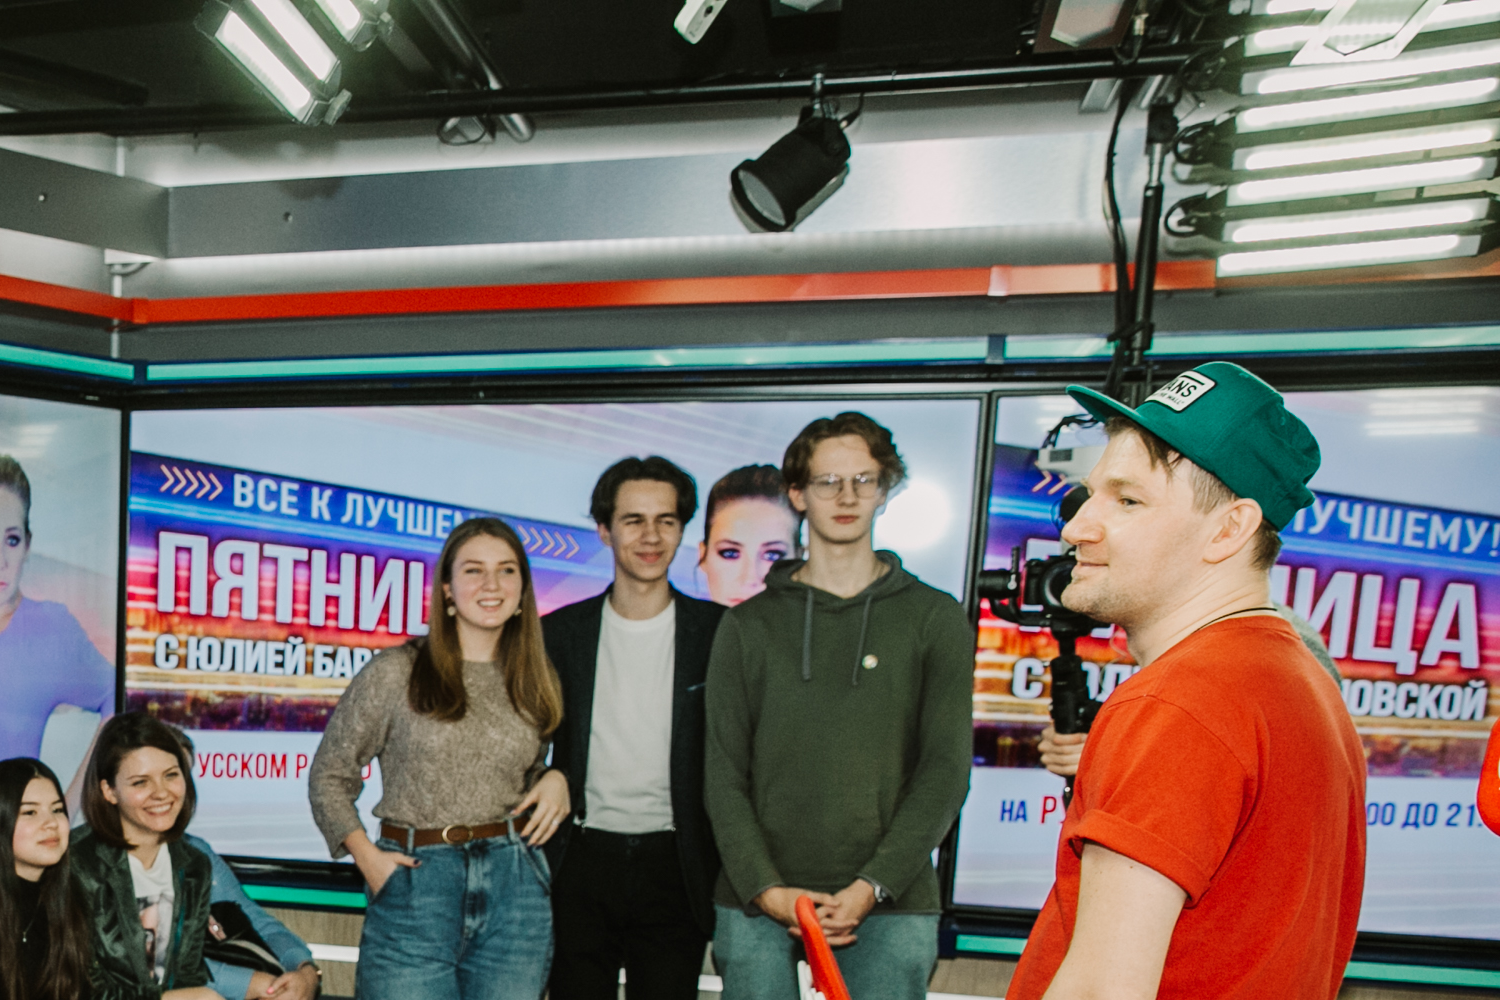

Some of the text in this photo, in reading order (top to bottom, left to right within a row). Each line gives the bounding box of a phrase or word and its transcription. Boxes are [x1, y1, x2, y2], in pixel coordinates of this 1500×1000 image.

[1160, 379, 1198, 398] ANS
[233, 473, 473, 539] ВСЕ К ЛУЧШЕ
[154, 633, 180, 670] С
[187, 636, 306, 676] ЮЛИЕЙ
[1011, 657, 1045, 700] С
[1342, 678, 1488, 721] ОВСКОЙ
[198, 752, 288, 779] УССКОМ
[1000, 800, 1028, 824] НА
[1401, 803, 1439, 830] ДО
[1445, 802, 1484, 828] 21.
